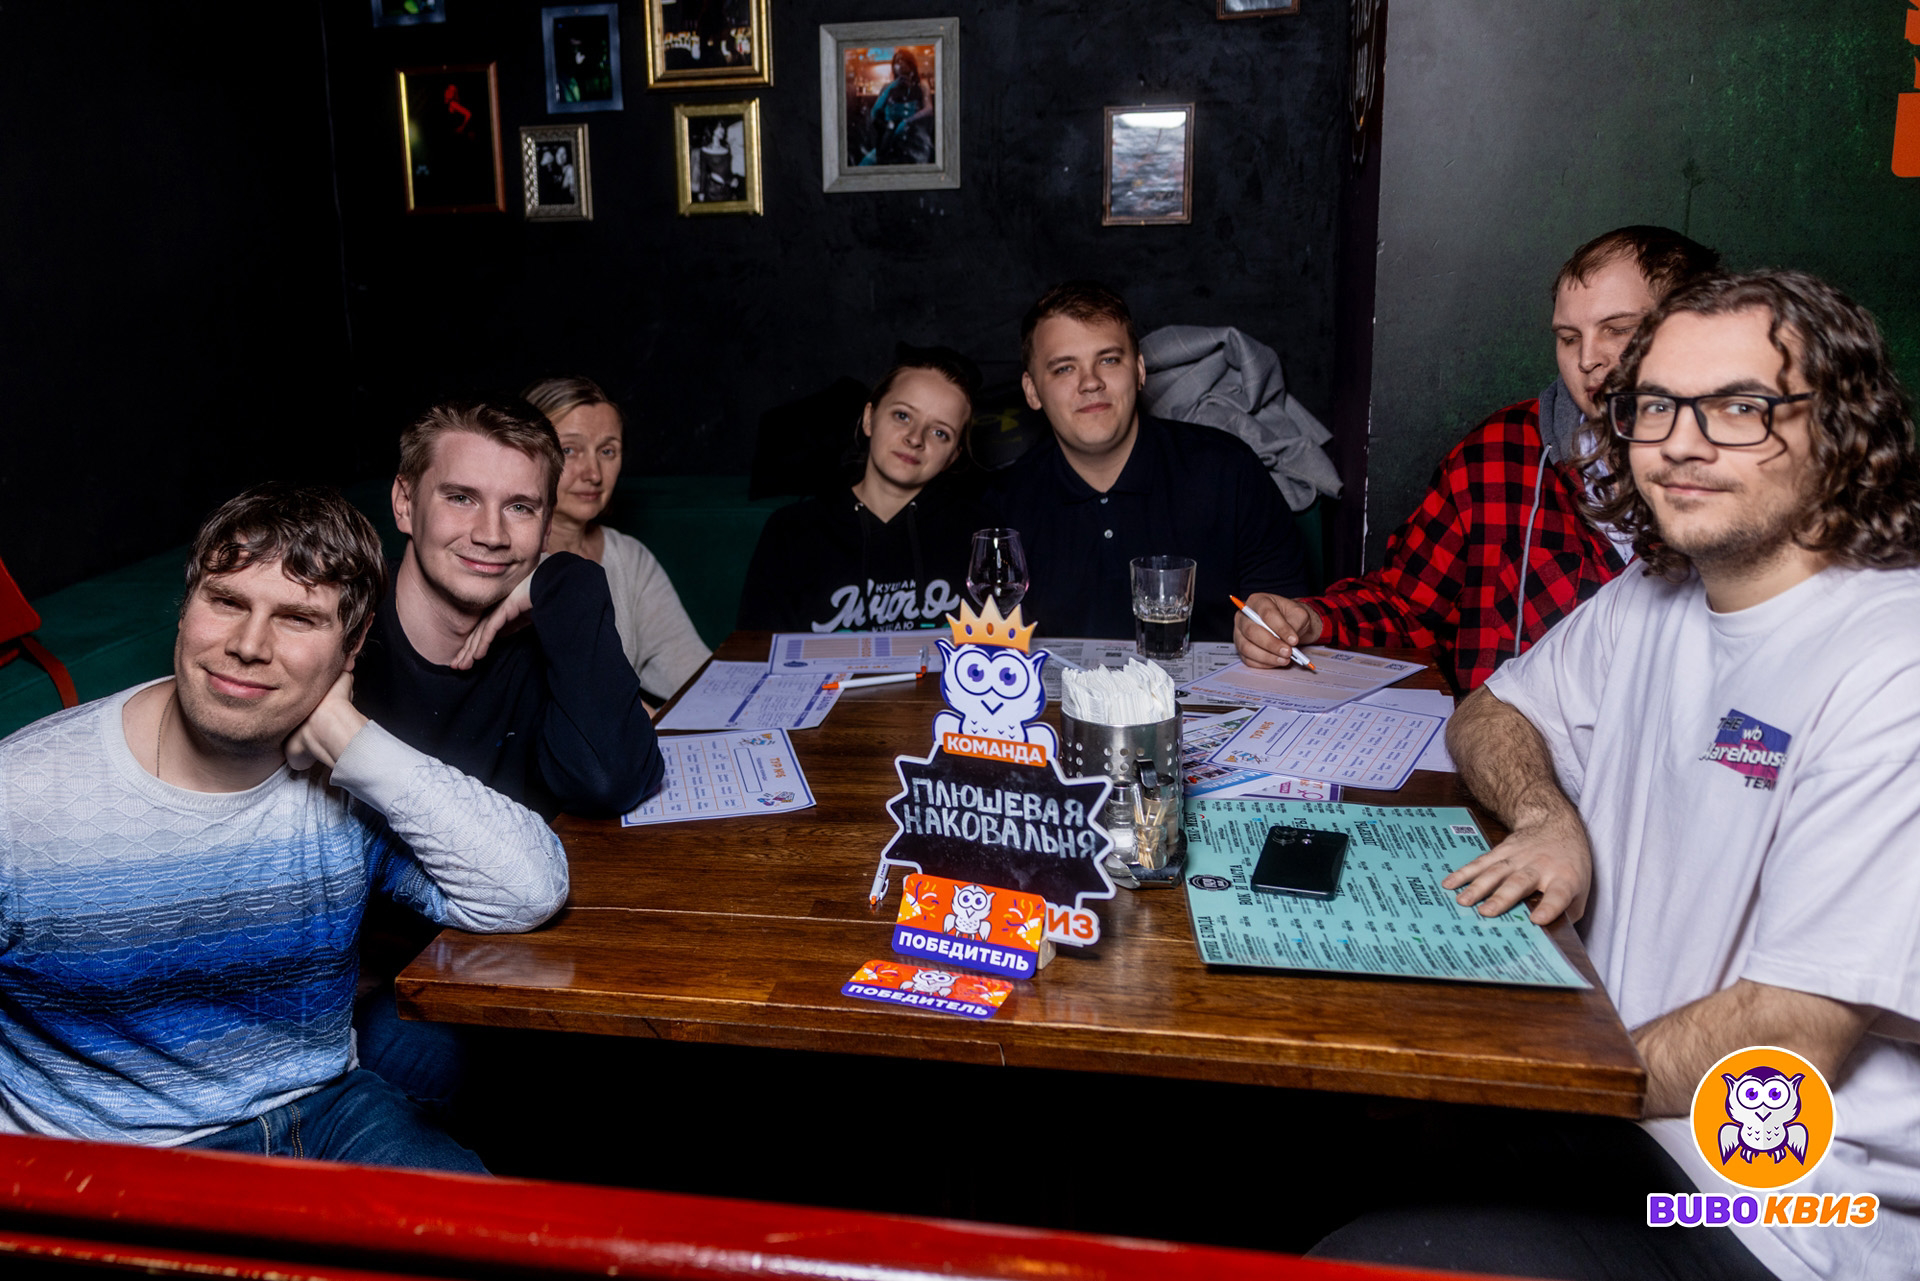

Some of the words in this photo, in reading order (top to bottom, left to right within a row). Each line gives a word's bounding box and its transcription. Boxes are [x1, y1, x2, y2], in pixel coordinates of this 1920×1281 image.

[1717, 717, 1744, 731] THE
[946, 735, 1044, 765] КОМАНДА
[912, 778, 1085, 828] ПЛЮШЕВАЯ
[904, 804, 1098, 859] НАКОВАЛЬНЯ
[1229, 865, 1247, 884] ПАСТА
[1406, 876, 1434, 906] БУРГЕРЫ
[1047, 908, 1094, 939] ИЗ
[898, 930, 1030, 972] ПОБЕДИТЕЛЬ
[847, 983, 989, 1017] ПОБЕДИТЕЛЬ
